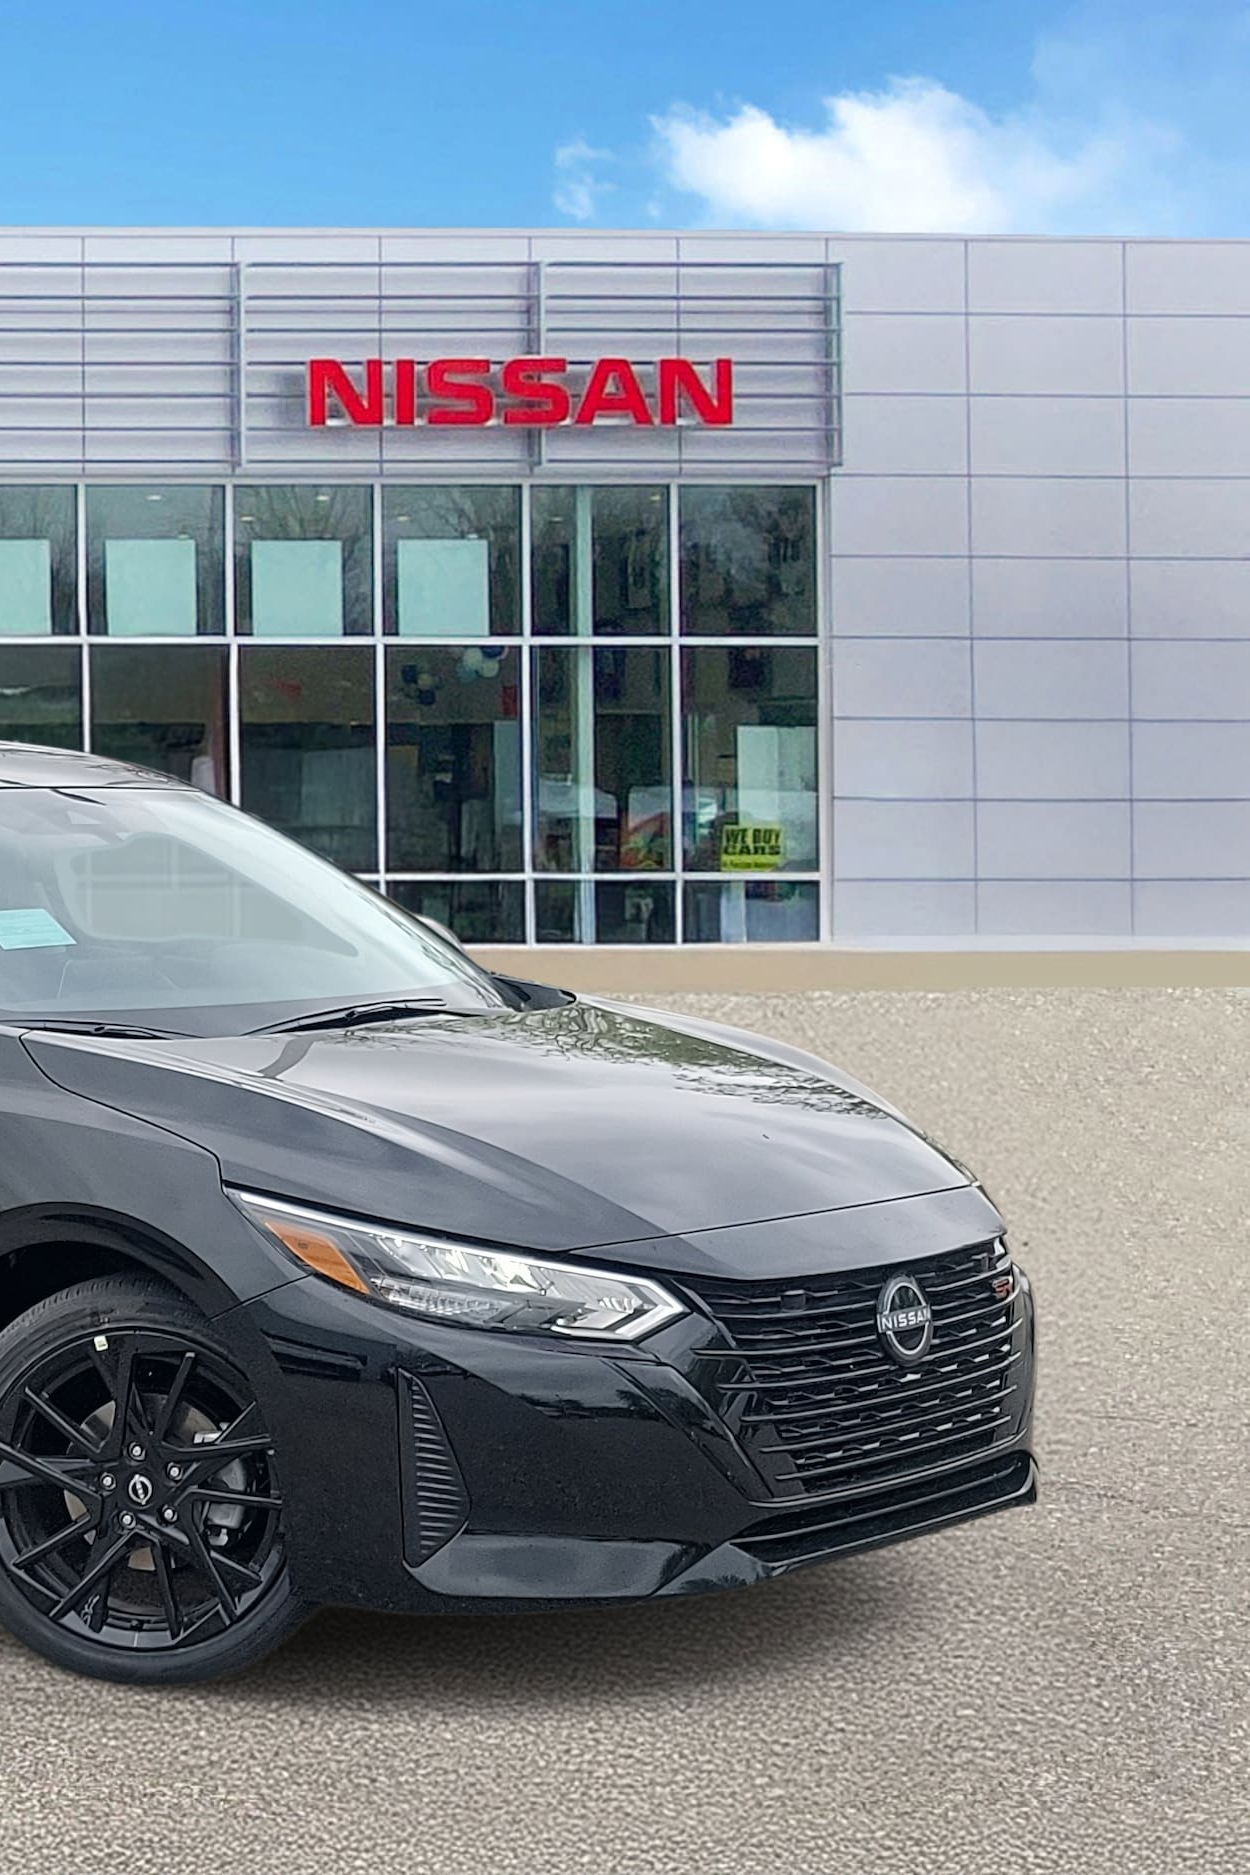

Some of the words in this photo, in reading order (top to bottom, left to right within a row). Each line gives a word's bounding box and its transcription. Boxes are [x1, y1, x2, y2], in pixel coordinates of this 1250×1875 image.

[306, 357, 734, 427] NISSAN
[725, 828, 748, 845] WE
[752, 828, 781, 845] BUY
[723, 844, 781, 856] CARS
[881, 1307, 931, 1330] NISSAN
